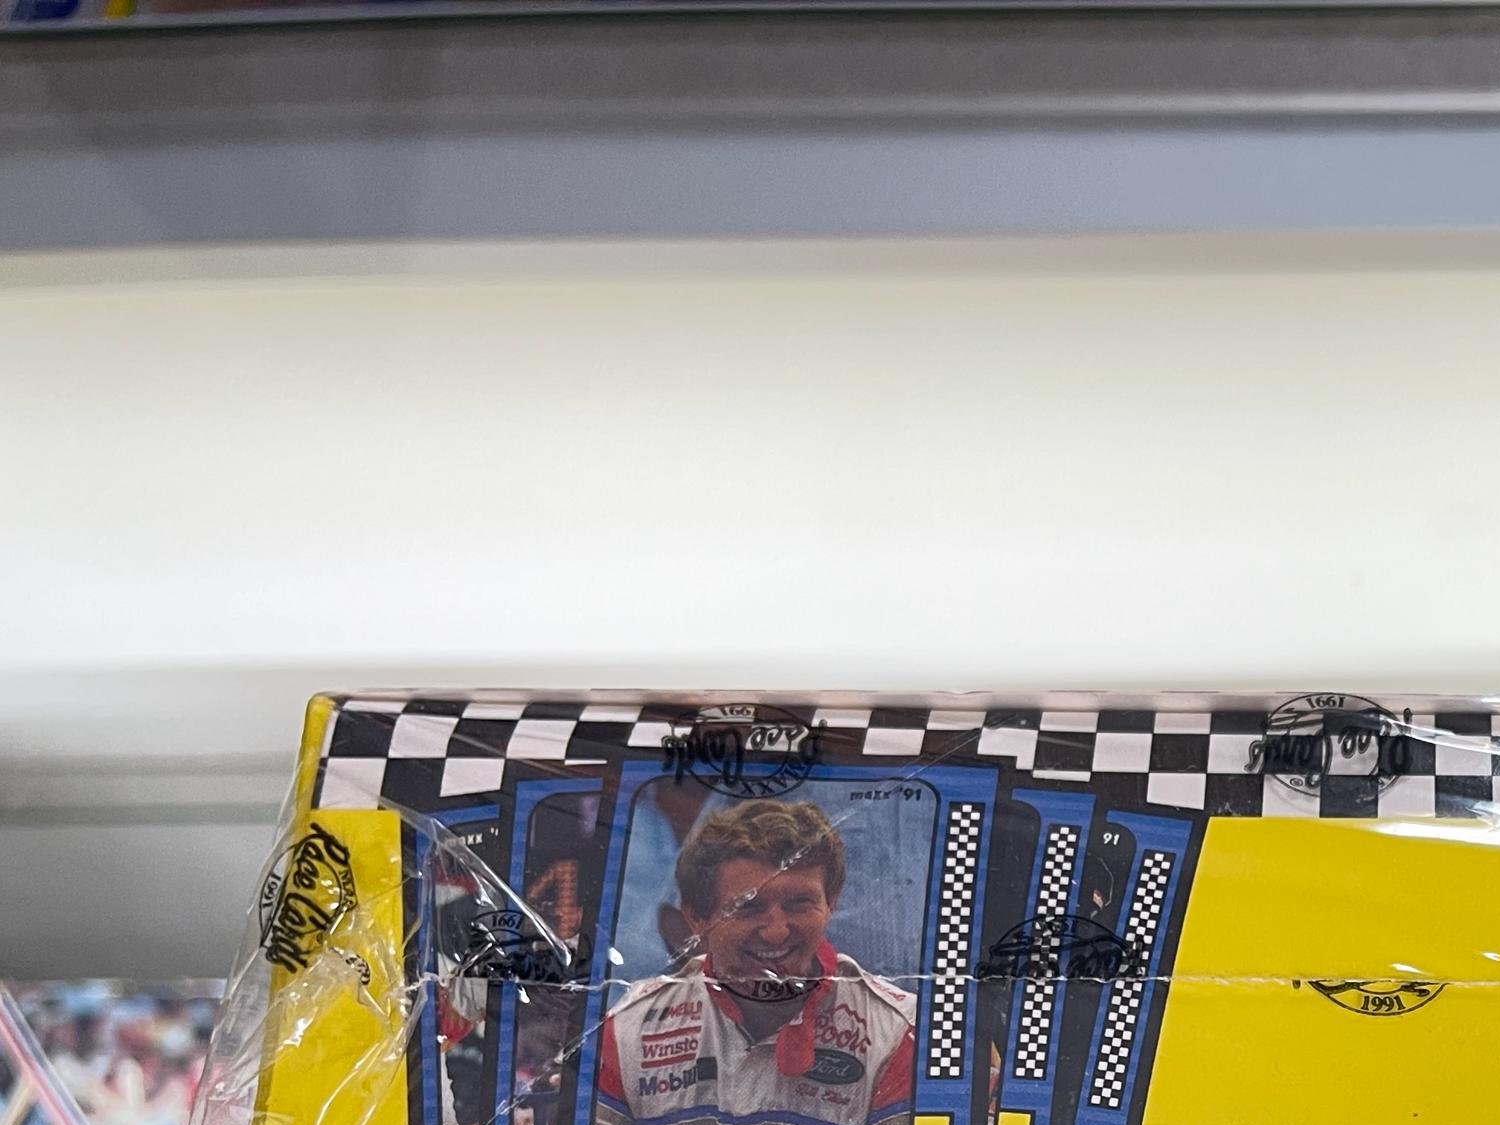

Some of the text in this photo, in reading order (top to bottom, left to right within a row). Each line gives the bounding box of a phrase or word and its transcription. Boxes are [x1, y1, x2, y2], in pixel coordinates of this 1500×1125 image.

[1305, 696, 1346, 712] 1991
[1360, 994, 1405, 1012] 1991
[641, 1037, 699, 1059] Winsto
